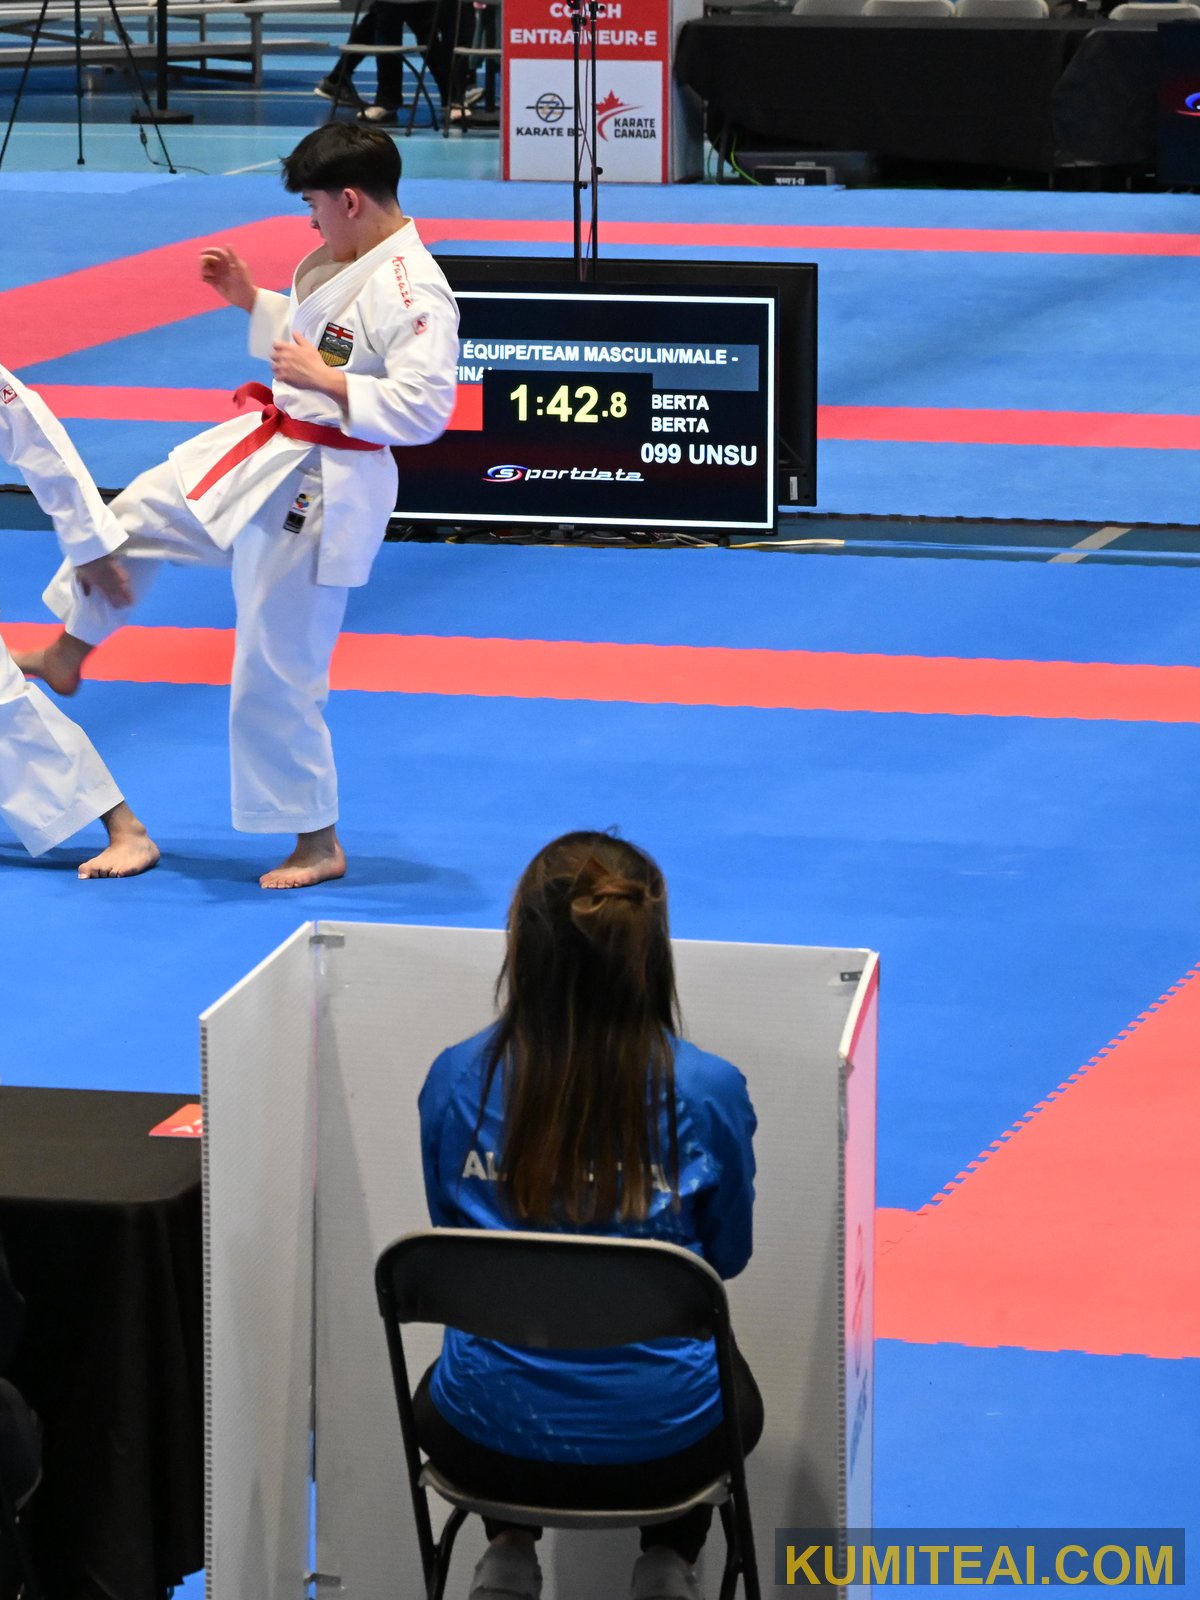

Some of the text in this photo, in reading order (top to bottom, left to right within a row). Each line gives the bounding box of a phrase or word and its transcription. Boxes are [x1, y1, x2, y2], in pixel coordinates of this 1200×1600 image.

[614, 118, 655, 128] KARATE
[516, 127, 564, 137] KARATE
[614, 128, 656, 139] CANADA
[463, 340, 578, 361] ÉQUIPE/TEAM
[583, 346, 728, 365] MASCULIN/MALE
[510, 384, 628, 423] 1:42.8
[651, 394, 709, 411] BERTA
[651, 416, 709, 433] BERTA
[641, 443, 757, 466] 099 UNSU
